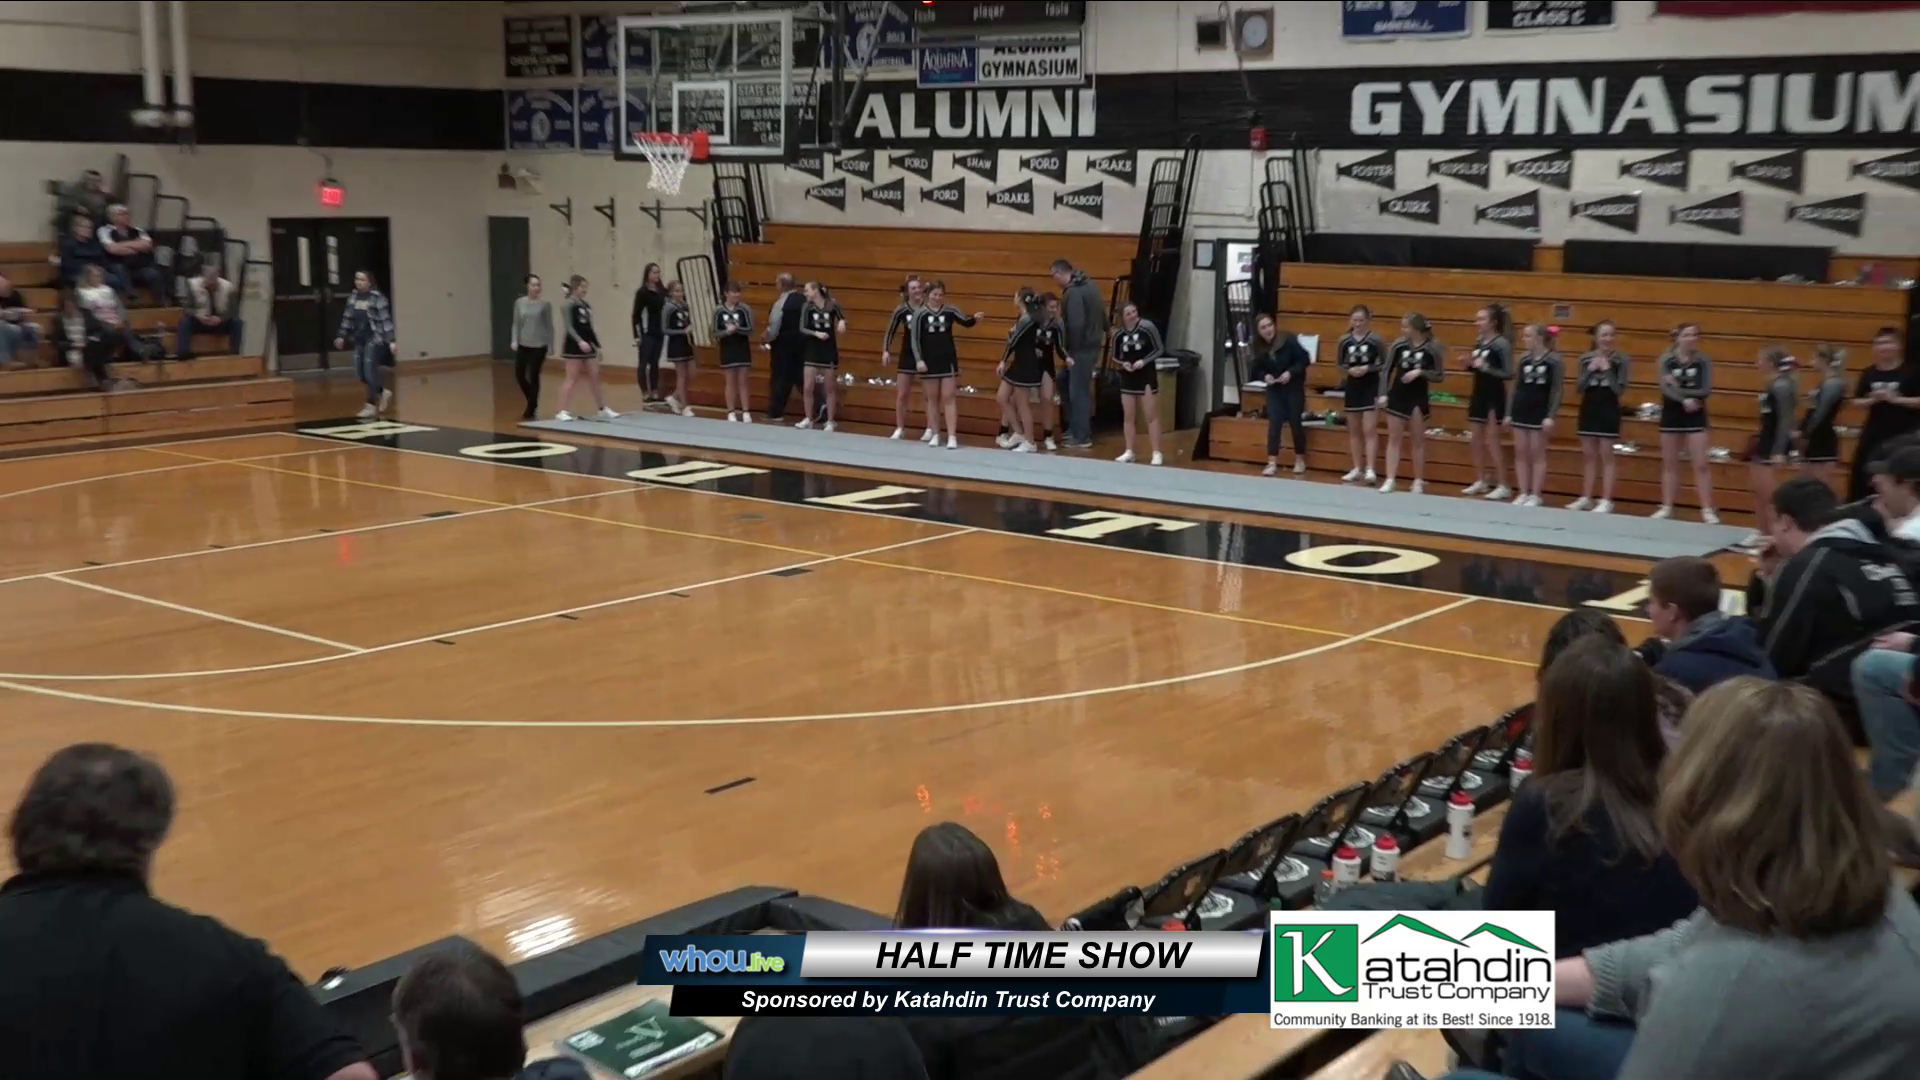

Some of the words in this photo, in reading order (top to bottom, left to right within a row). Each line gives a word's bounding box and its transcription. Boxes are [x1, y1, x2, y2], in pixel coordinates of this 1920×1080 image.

[982, 58, 1078, 78] GYMNASIUM
[1349, 70, 1920, 136] GYMNASIUM
[854, 89, 1097, 139] ALUMNI
[841, 161, 871, 172] COSBY
[904, 157, 929, 170] FORD
[966, 157, 992, 170] SHAW
[1029, 157, 1060, 171] FORD
[1095, 157, 1133, 173] DRAKE
[1351, 164, 1395, 178] FOSTER
[872, 189, 902, 201] HARRIS
[932, 189, 959, 201] FORD
[995, 191, 1031, 205] DRAKE
[1061, 194, 1104, 207] PEABODY
